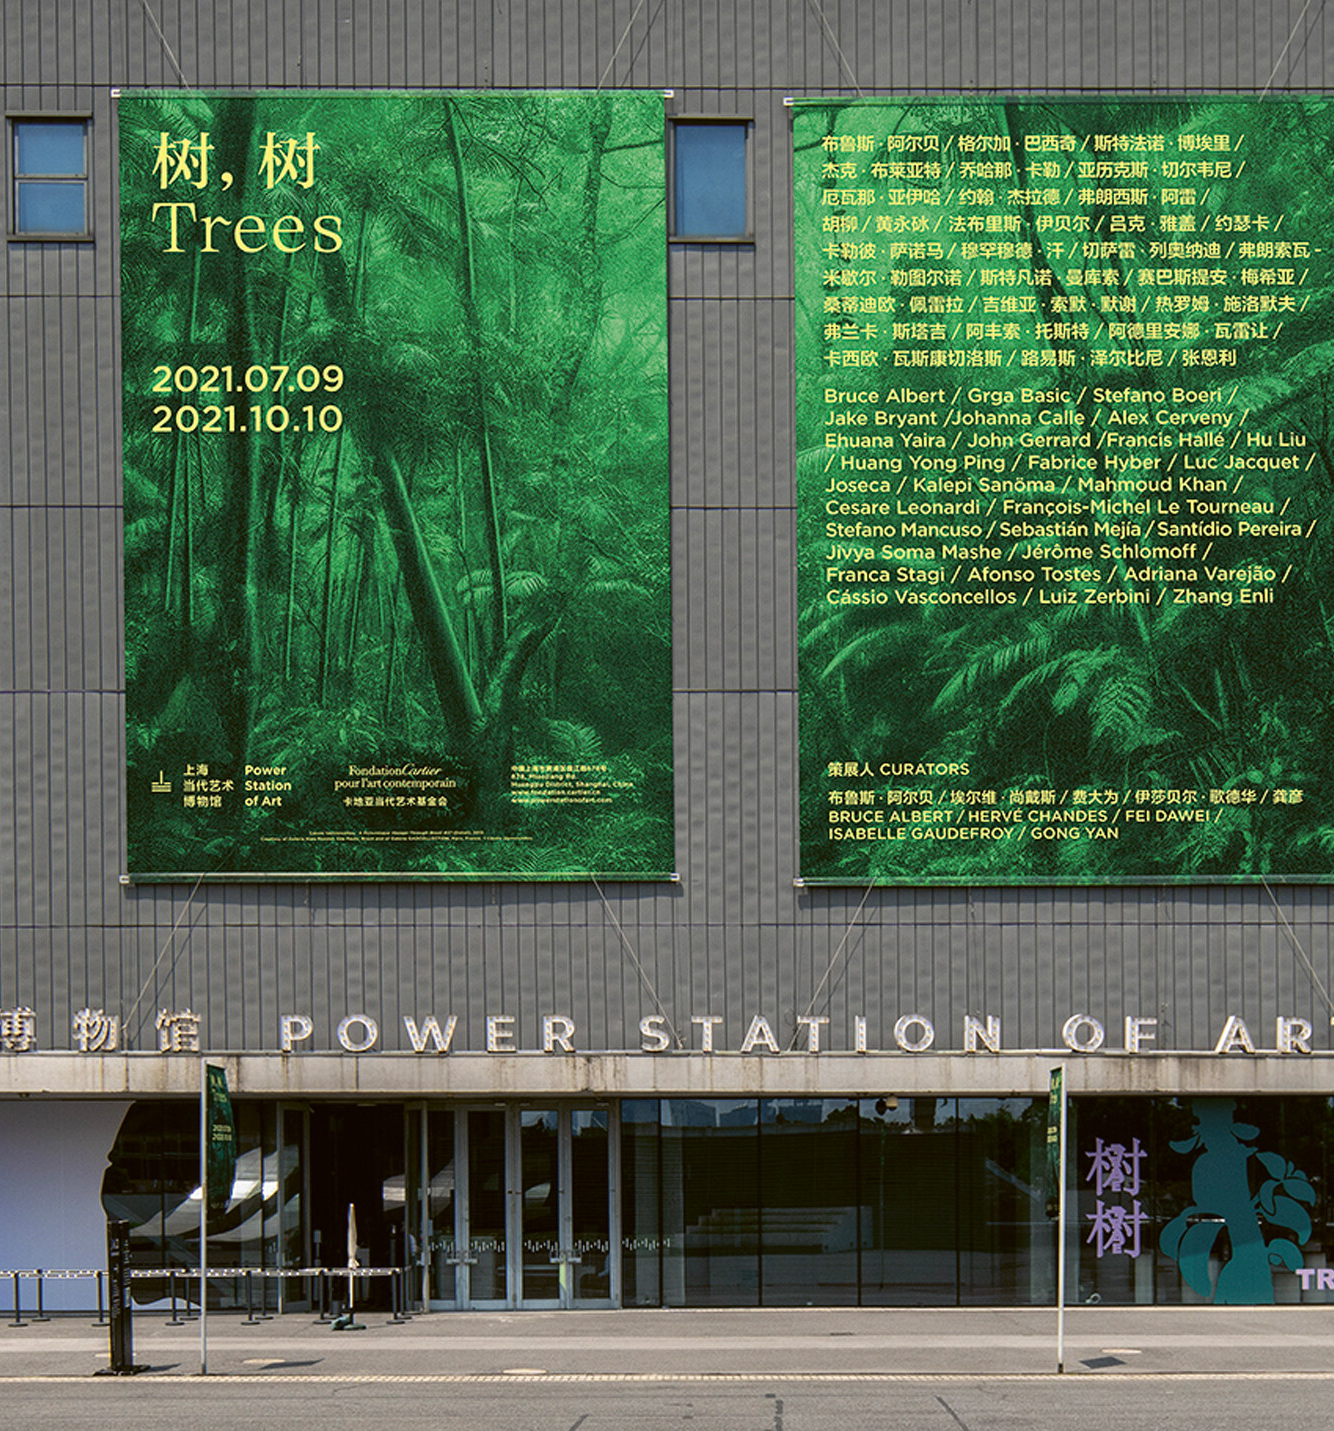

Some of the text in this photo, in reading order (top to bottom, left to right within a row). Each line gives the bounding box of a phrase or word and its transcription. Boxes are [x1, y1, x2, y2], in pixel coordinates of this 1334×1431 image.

[152, 203, 342, 252] Trees
[153, 365, 343, 392] 2021.07.09
[825, 387, 1221, 405] Bruce Albert Grga Basic Stefano Boeri
[153, 405, 342, 432] 2021.10.10
[825, 409, 1233, 428] Jake Bryant Johanna Calle Alex Cerveny
[826, 432, 1305, 448] Ehuana Yaira John Gerrard Francis Hallé Hu Liu
[842, 455, 1299, 473] Huang Yong Ping Fabrice Hyber Luc Jacquet
[826, 477, 1226, 494] Joseca Kalepi Sanöma Mahmoud Khan
[826, 499, 1273, 516] Cesare Leonardi François-Michel Le Tourneau
[826, 521, 1301, 539] Stefano Mancuso Sebastián Mejía Santídio Pereira
[826, 544, 1196, 562] Jivya Soma Mashe Jérôme Schlomoff
[827, 566, 1275, 584] Franca Stagi Afonso Tostes Adriana Varejão
[827, 588, 1273, 606] Cássio Vasconcellos Luiz Zerbini Zhang Enli
[244, 764, 287, 776] Power
[828, 762, 969, 776] 策展人 CURATORS
[244, 780, 292, 791] Station
[244, 795, 282, 806] of Art
[830, 809, 1209, 822] BRUCE ALBERT HERVÉ CHANDES FEI DAWEI
[830, 827, 1118, 840] ISABELLE GAUDEFROY GONG YAN
[281, 1014, 576, 1052] POWER
[639, 1014, 1001, 1052] STATION
[1062, 1013, 1157, 1053] OF
